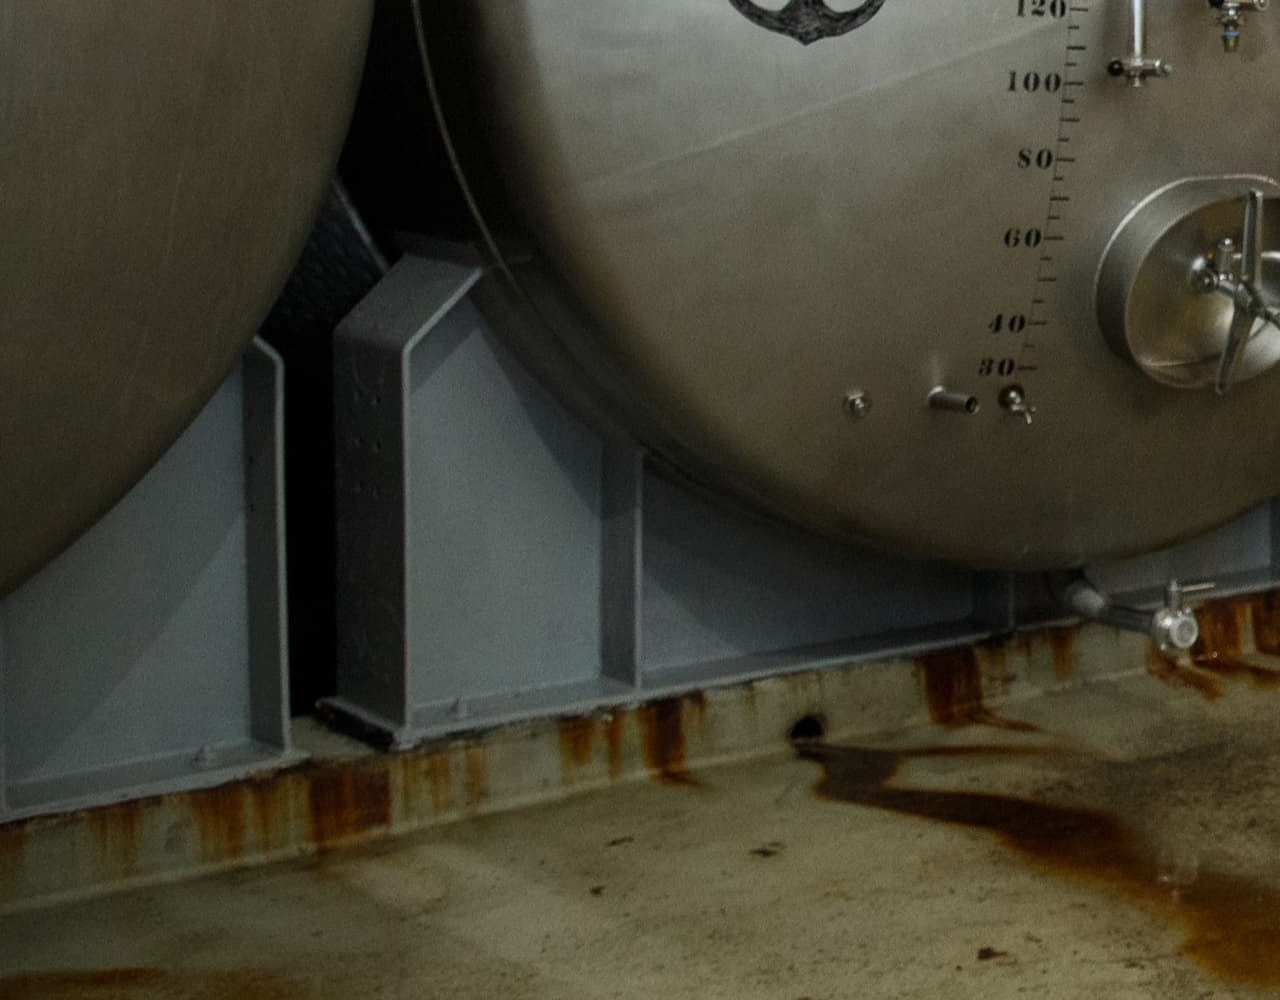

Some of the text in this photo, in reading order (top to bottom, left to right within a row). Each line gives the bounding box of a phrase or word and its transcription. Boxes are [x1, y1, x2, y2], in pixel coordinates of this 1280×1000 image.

[1008, 71, 1062, 93] 100
[1017, 149, 1053, 170] 80
[1004, 228, 1042, 248] 60
[989, 314, 1026, 334] 40
